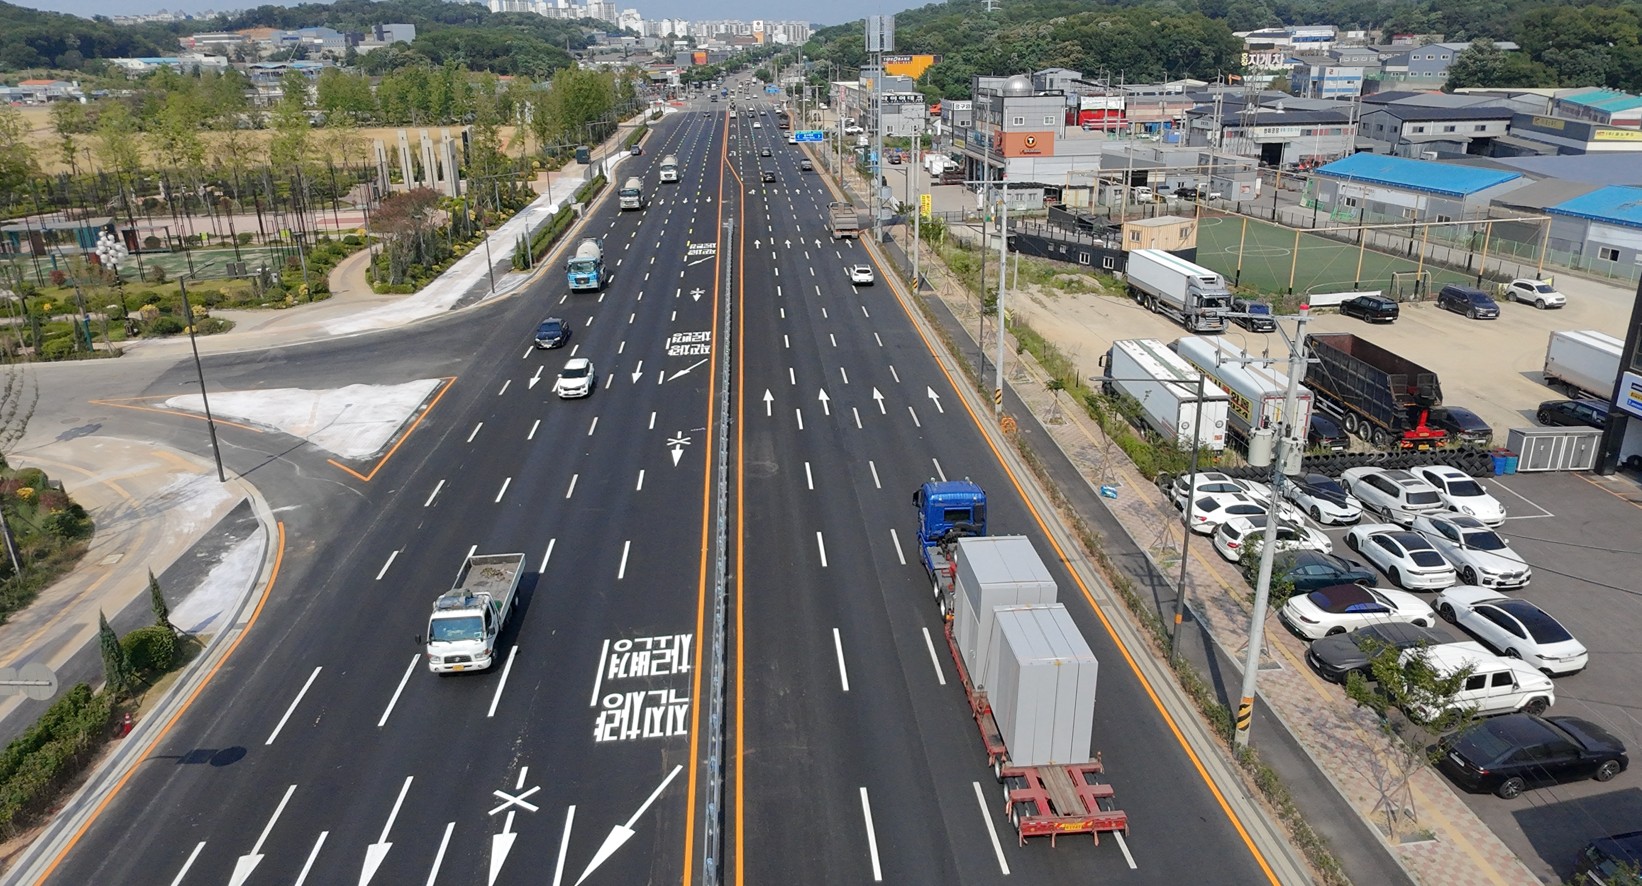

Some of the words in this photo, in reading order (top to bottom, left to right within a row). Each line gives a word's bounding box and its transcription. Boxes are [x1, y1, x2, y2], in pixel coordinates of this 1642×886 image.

[1248, 53, 1284, 67] 지게차
[671, 331, 711, 343] 차로변경
[667, 344, 711, 356] 직진차량
[608, 633, 693, 680] 차로변경
[593, 688, 690, 742] 직진차량
